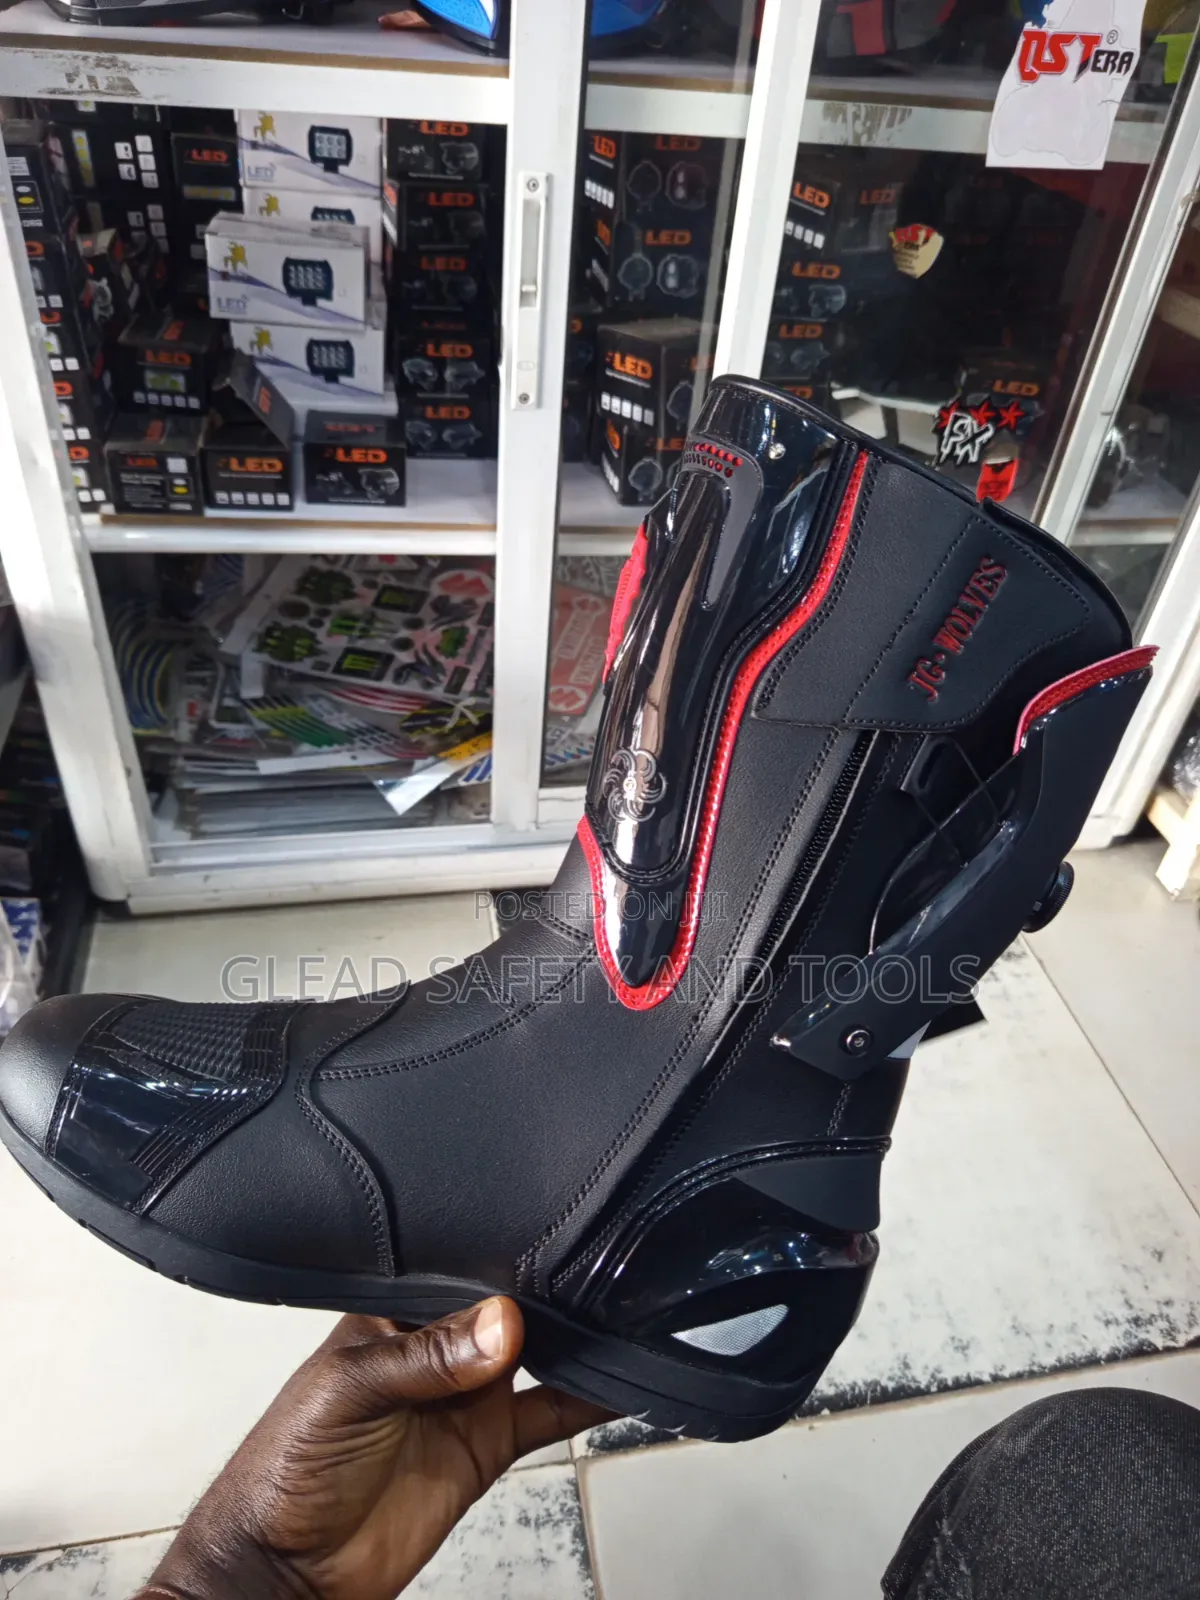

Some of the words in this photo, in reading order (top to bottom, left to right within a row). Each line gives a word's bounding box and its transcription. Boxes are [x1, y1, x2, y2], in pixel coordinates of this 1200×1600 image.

[420, 121, 469, 137] LED
[190, 148, 229, 162] LED
[593, 135, 616, 160] LED
[428, 192, 475, 207] LED
[792, 181, 831, 209] LED
[645, 229, 692, 246] LED
[421, 256, 467, 271] LED
[791, 261, 841, 280] LED
[779, 323, 823, 339] LED
[426, 342, 474, 359] LED
[612, 352, 654, 380] LED
[993, 380, 1040, 397] LED
[425, 404, 472, 420] LED
[335, 447, 388, 464] LED
[228, 456, 284, 474] LED
